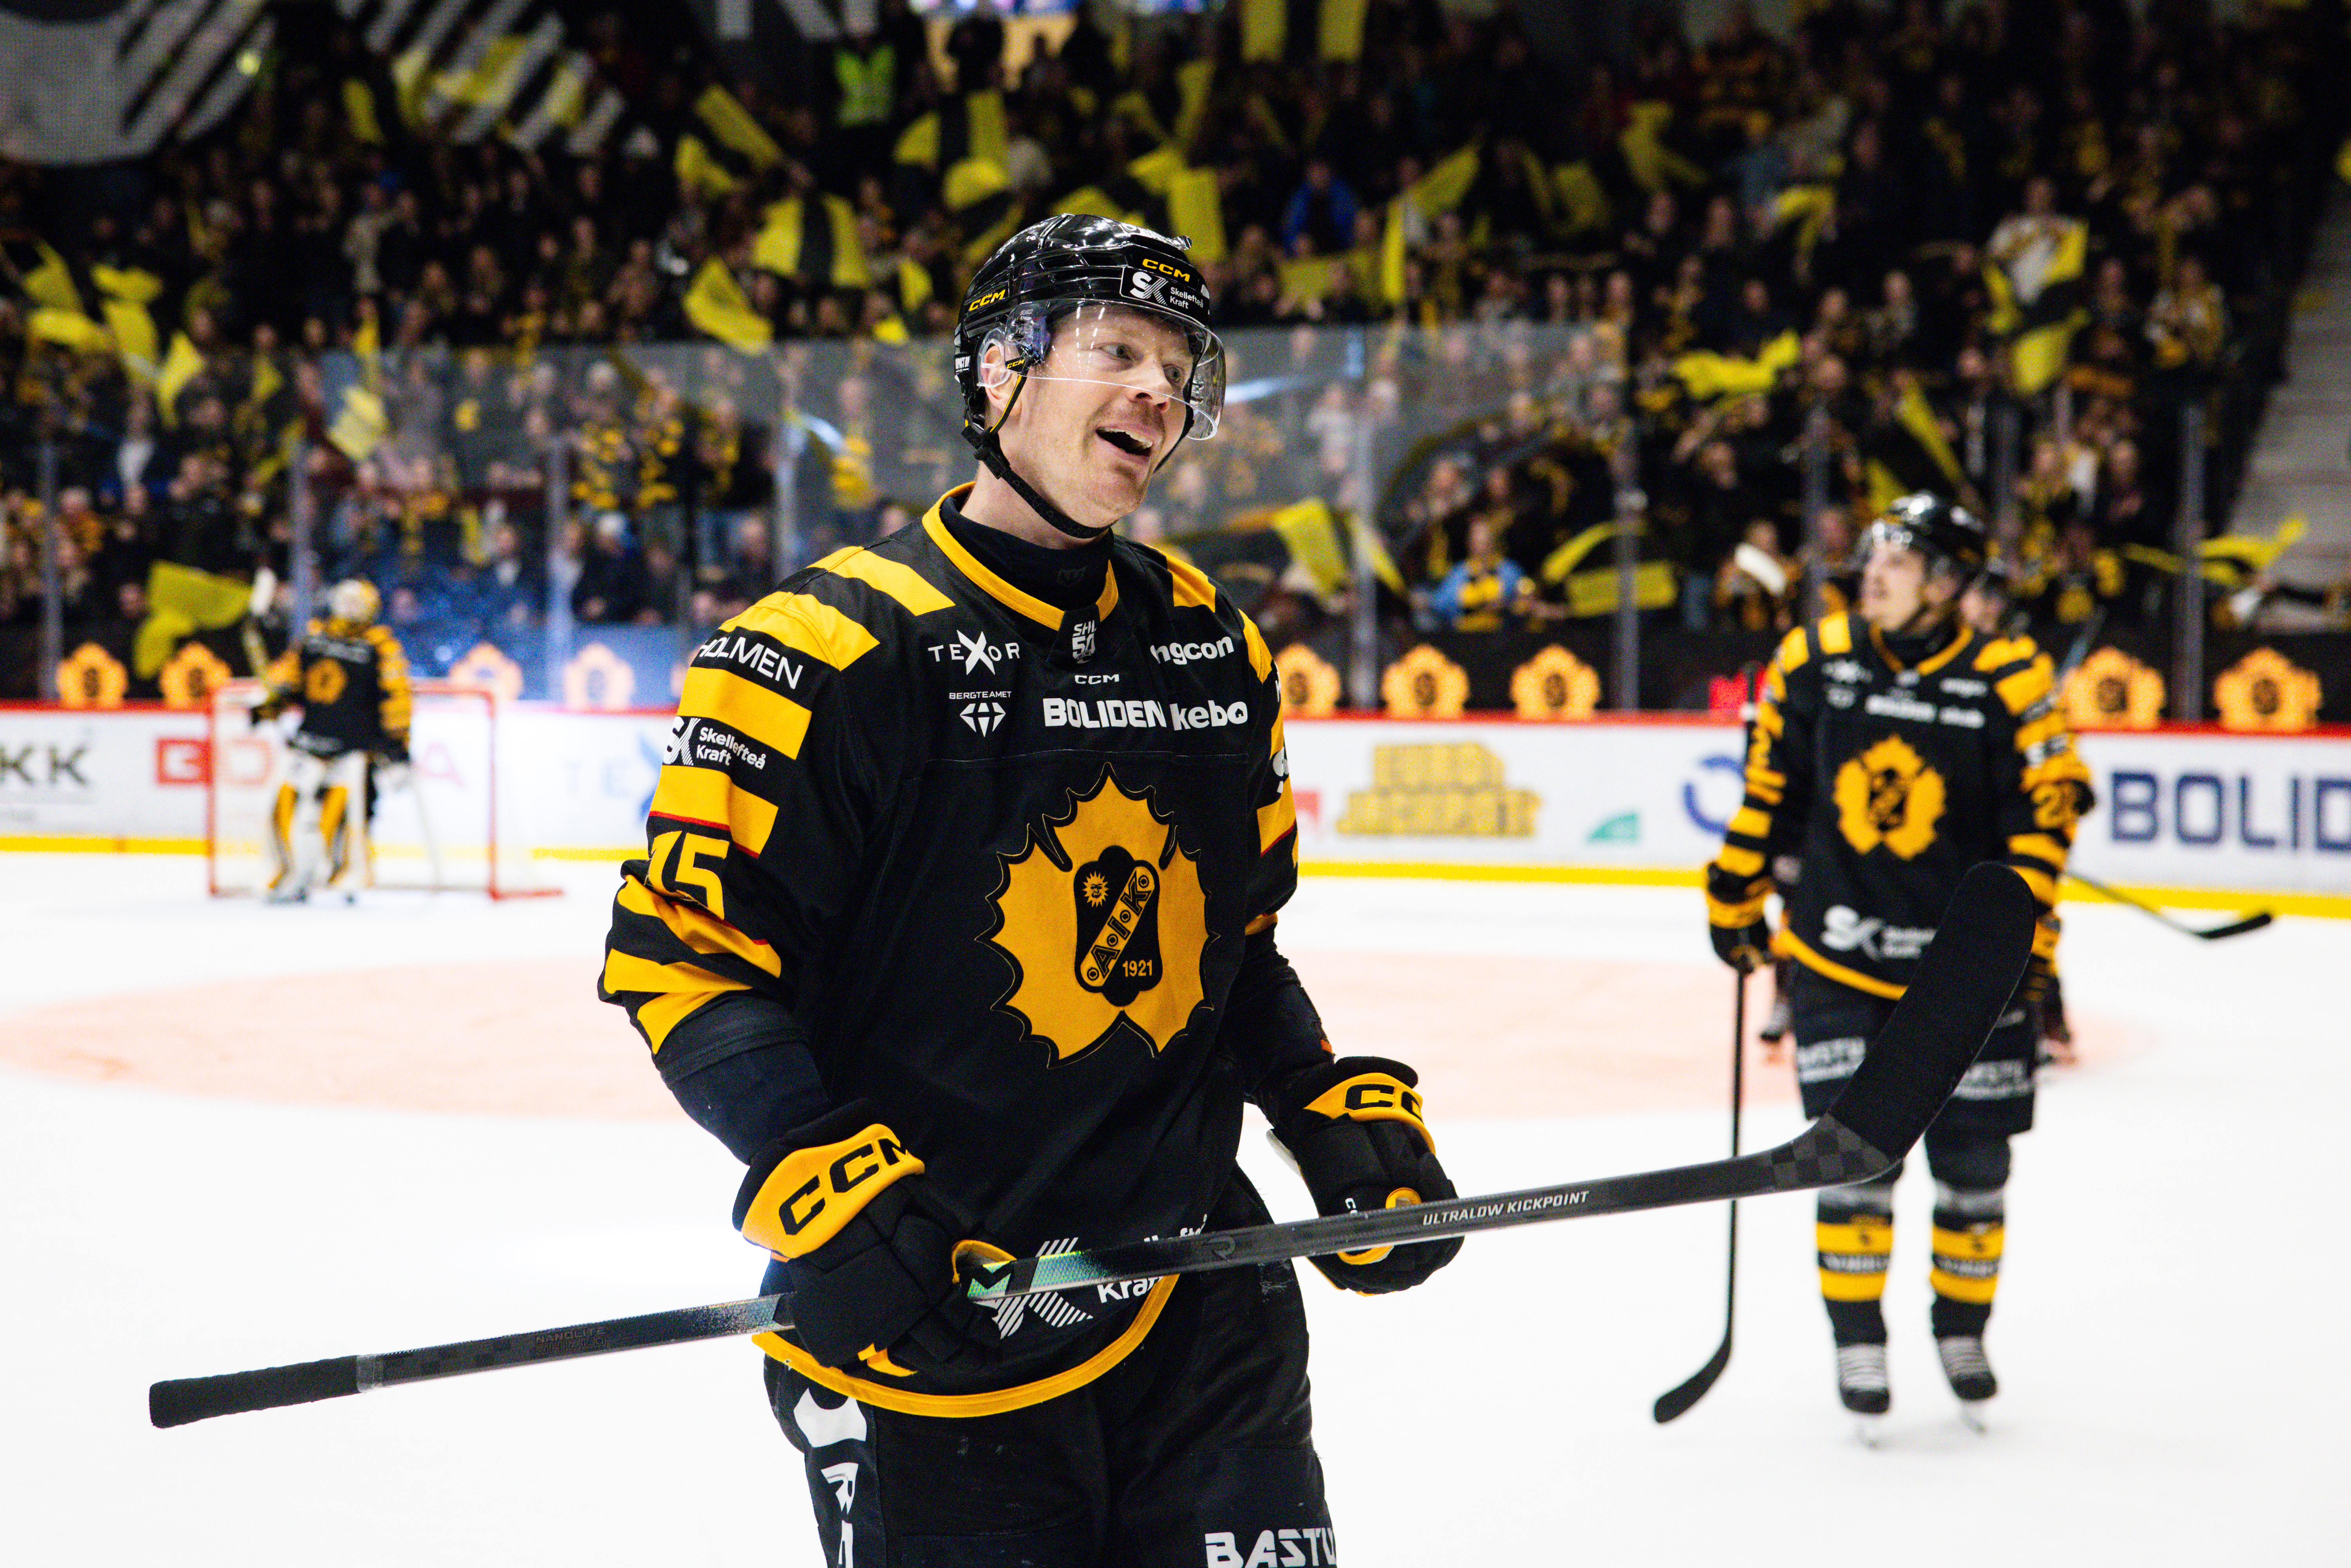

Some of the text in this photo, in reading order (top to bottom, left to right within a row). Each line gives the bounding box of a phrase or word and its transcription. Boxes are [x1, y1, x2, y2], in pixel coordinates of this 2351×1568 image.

[1142, 258, 1190, 282] CCM
[969, 289, 1006, 311] CCM
[1170, 286, 1204, 308] Skellefteå
[1170, 296, 1189, 309] Kraft
[1007, 359, 1025, 369] CCM
[1072, 620, 1097, 637] SHL
[928, 630, 1020, 675] TEXOR
[1072, 633, 1096, 659] 50
[699, 636, 803, 690] HOLMEN
[1075, 674, 1119, 684] CCM
[949, 691, 1011, 699] BERGTEAMET
[1043, 698, 1248, 731] BOLIDEN kebo
[696, 744, 732, 766] Kraft
[699, 727, 766, 770] Skellefteå
[1123, 959, 1152, 977] 1921
[1422, 1190, 1590, 1226] ULTRALOW KICKPOINT
[535, 1325, 606, 1343] NANOLITE
